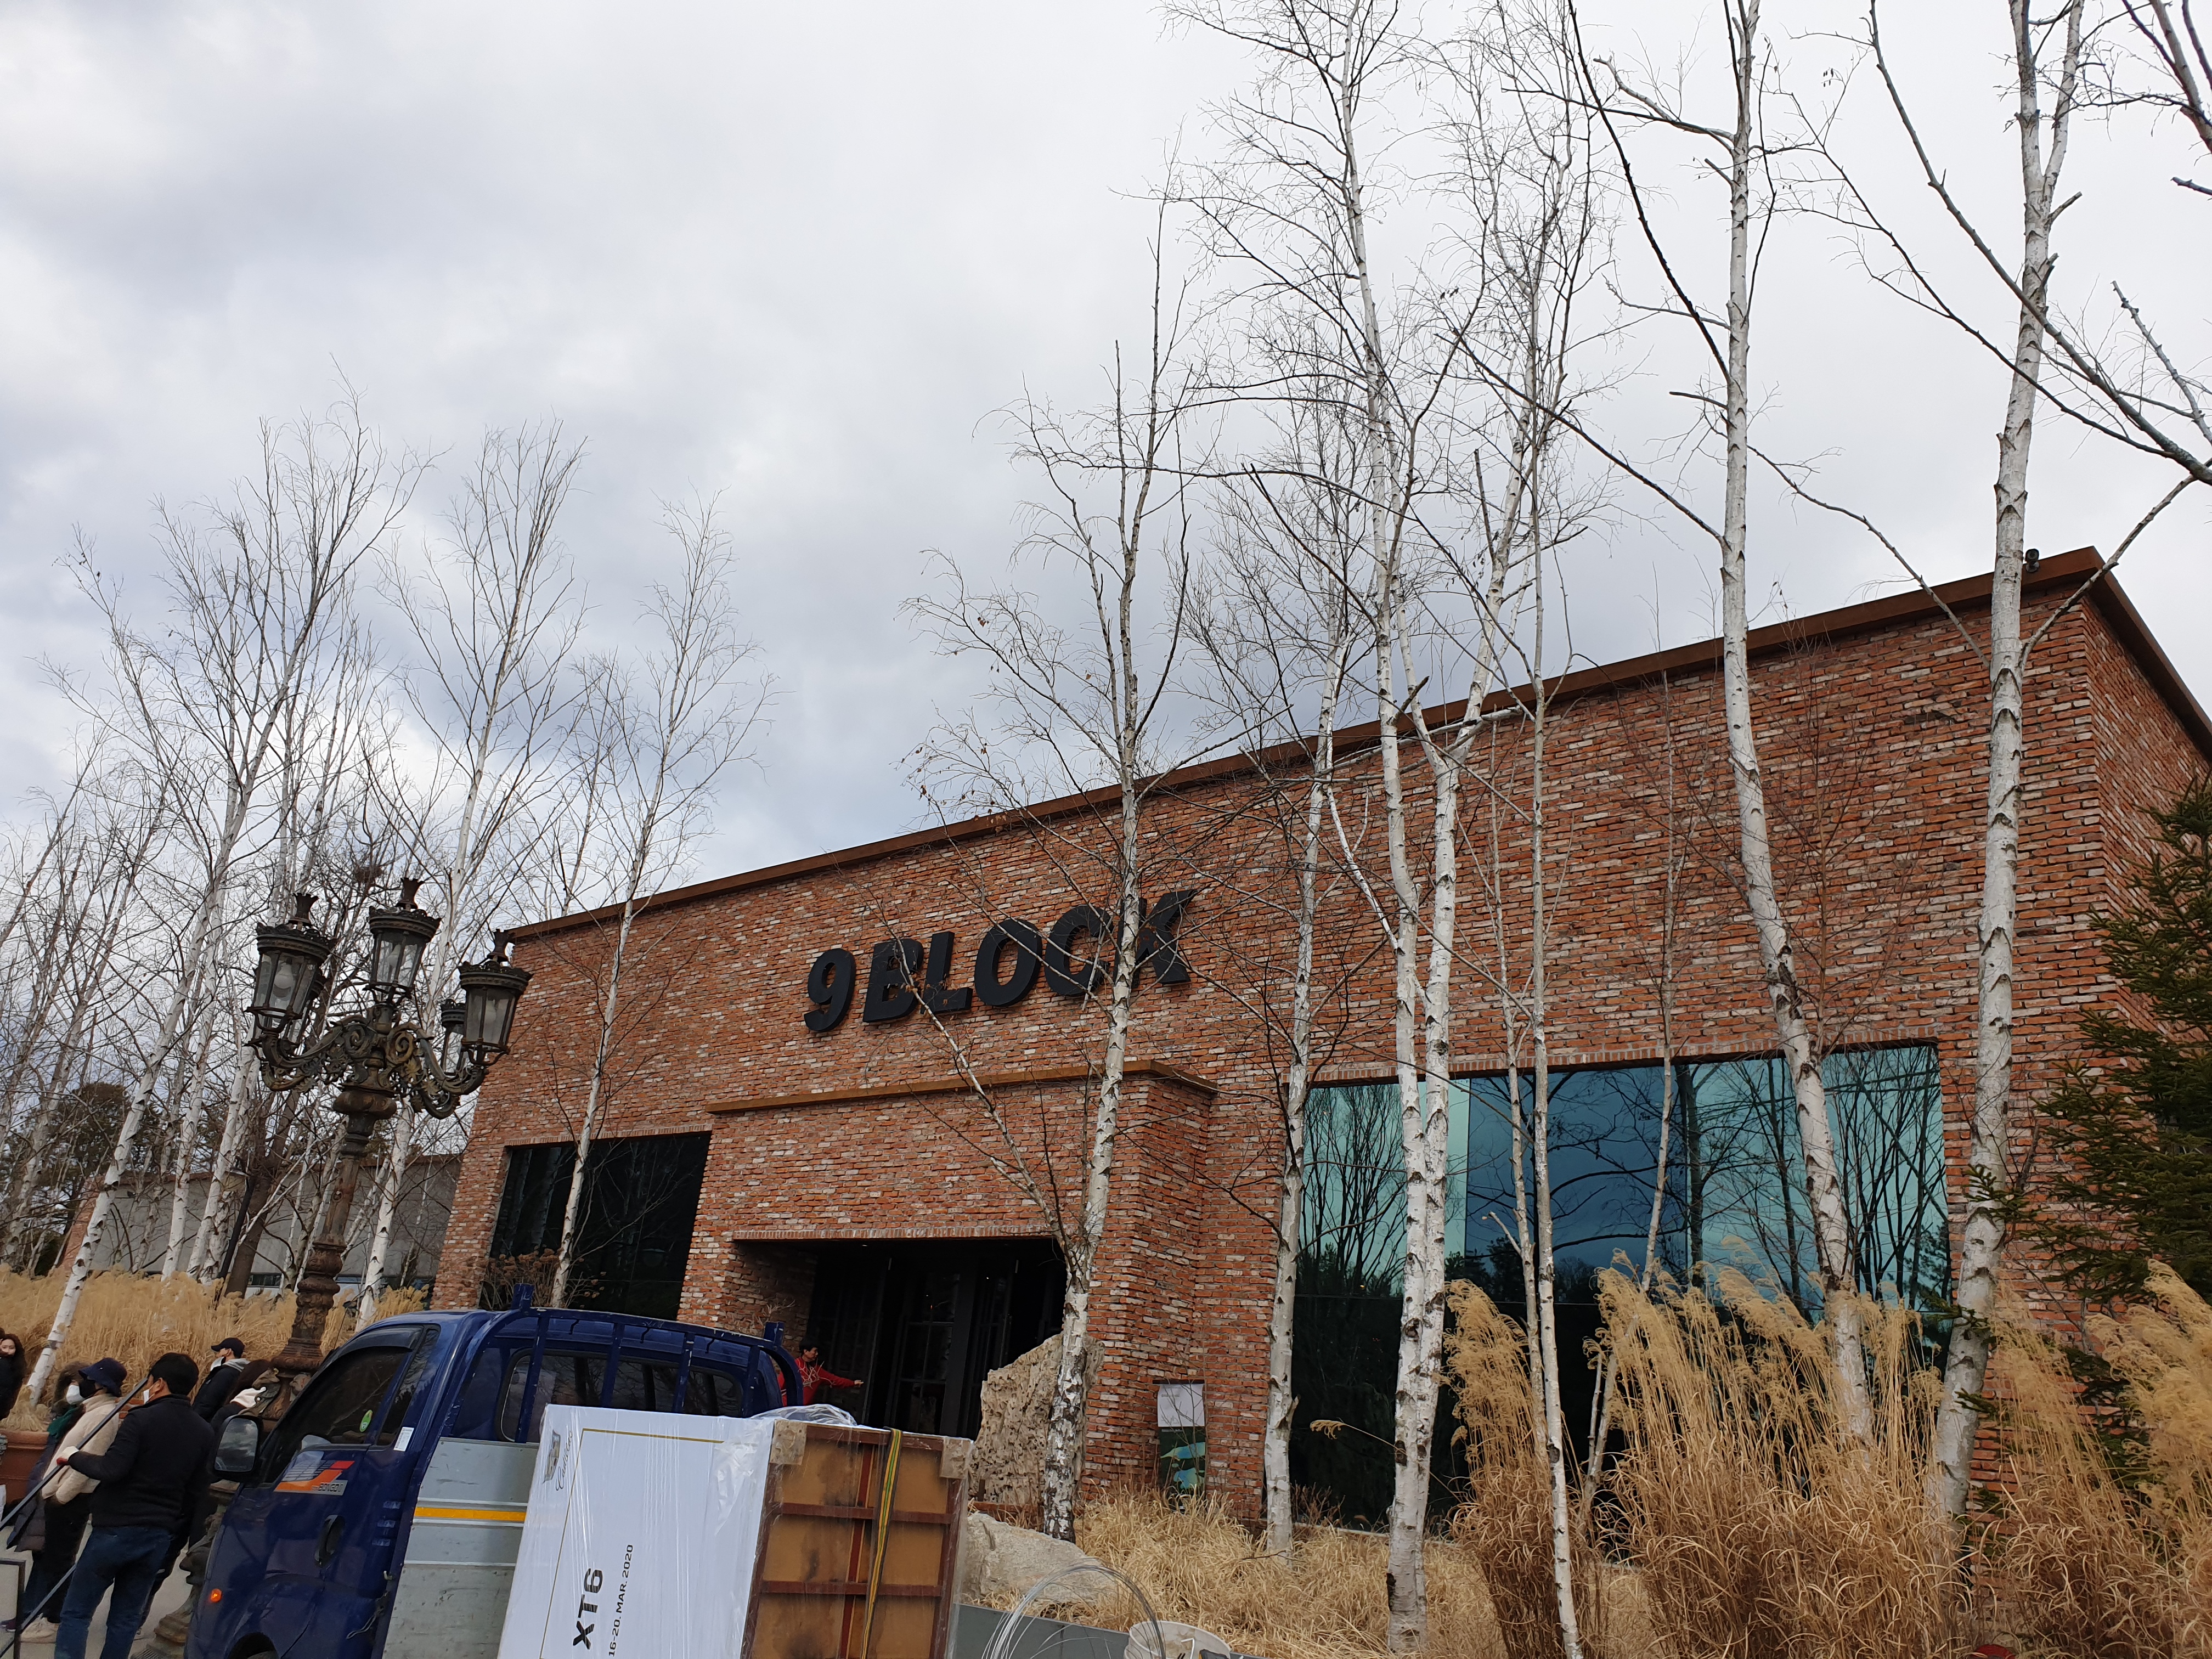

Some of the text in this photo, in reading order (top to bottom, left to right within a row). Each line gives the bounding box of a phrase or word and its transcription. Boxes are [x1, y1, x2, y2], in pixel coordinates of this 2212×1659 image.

[572, 1568, 603, 1650] XT6
[608, 1544, 634, 1657] 16-20. MAR. 2020
